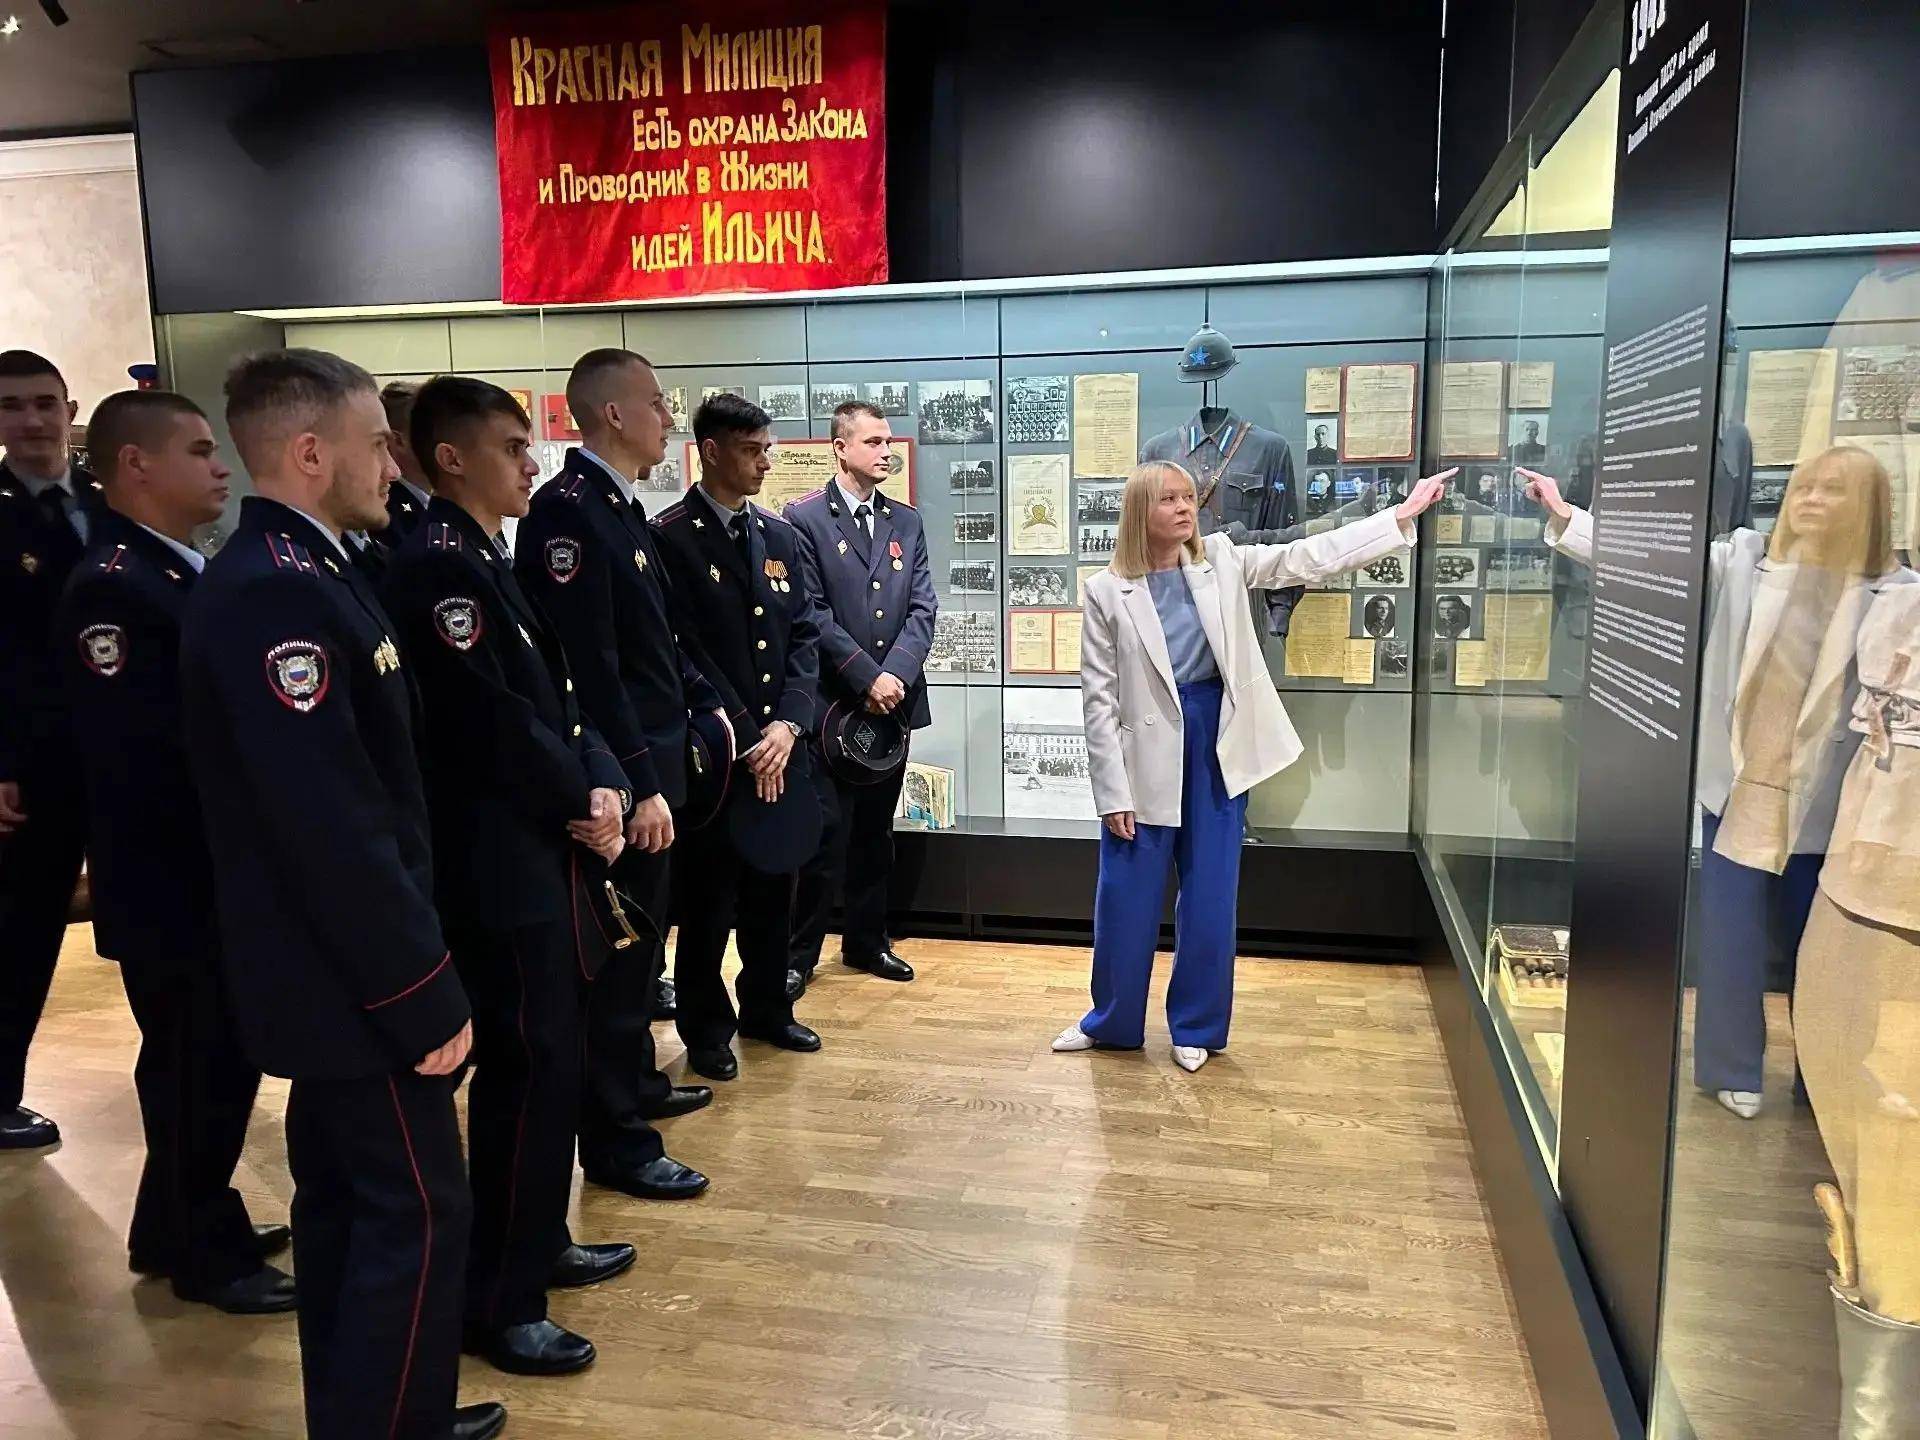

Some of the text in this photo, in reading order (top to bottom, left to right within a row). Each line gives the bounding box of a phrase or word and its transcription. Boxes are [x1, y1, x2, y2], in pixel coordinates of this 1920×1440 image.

[434, 597, 474, 612] ПОЛИЦИЯ
[267, 640, 321, 660] ПОЛИЦИЯ
[293, 697, 315, 711] МВД
